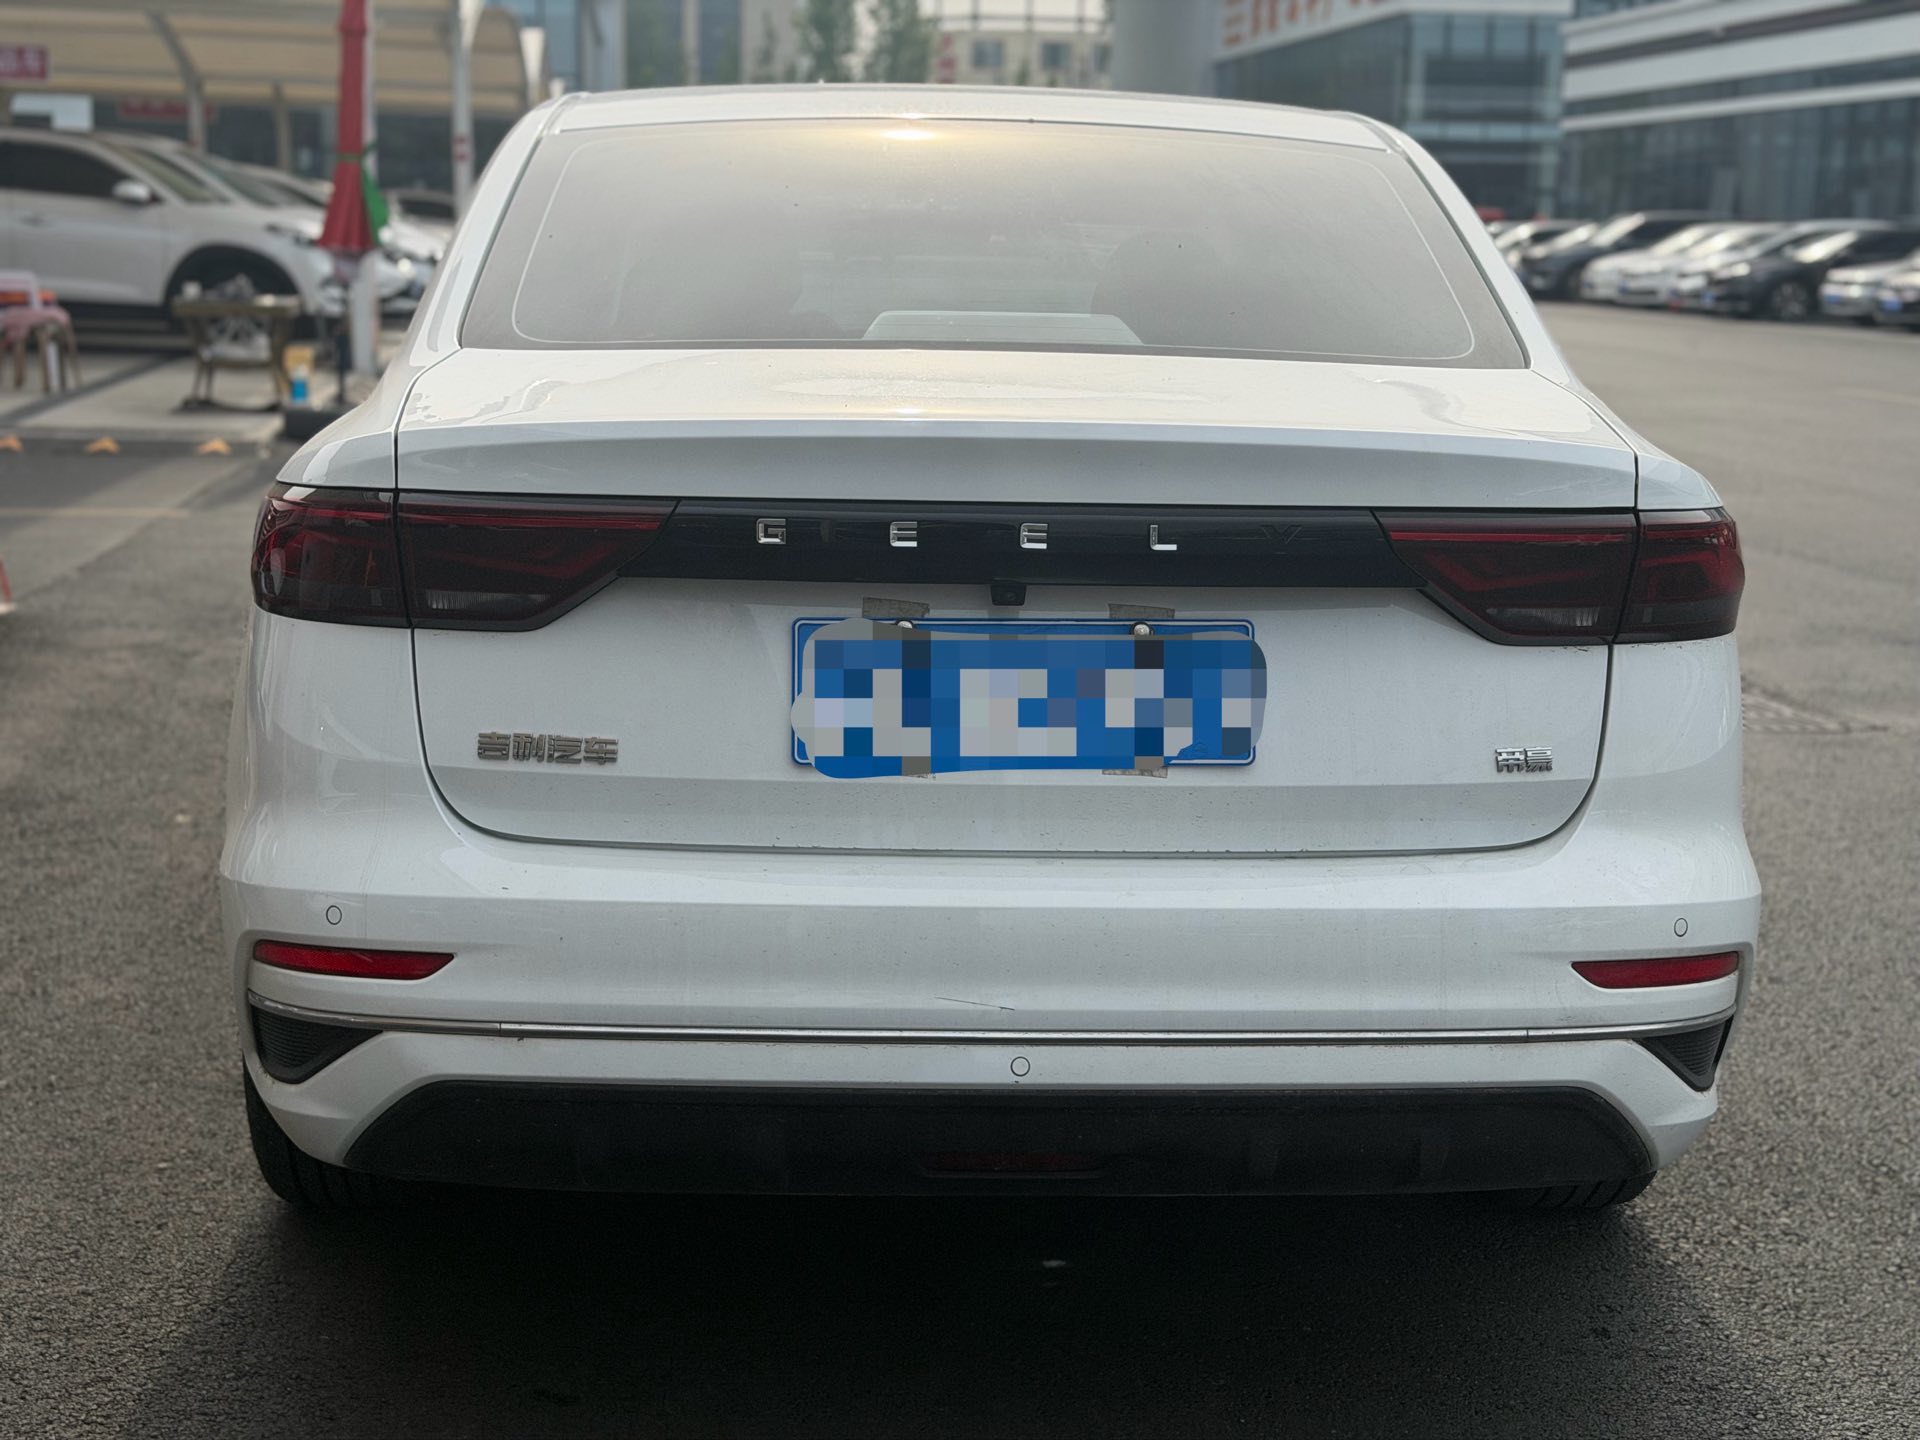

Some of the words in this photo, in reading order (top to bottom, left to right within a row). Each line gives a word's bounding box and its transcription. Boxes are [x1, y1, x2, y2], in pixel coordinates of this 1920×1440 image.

[477, 732, 618, 765] 吉利汽车
[1495, 747, 1552, 773] 帝豪
